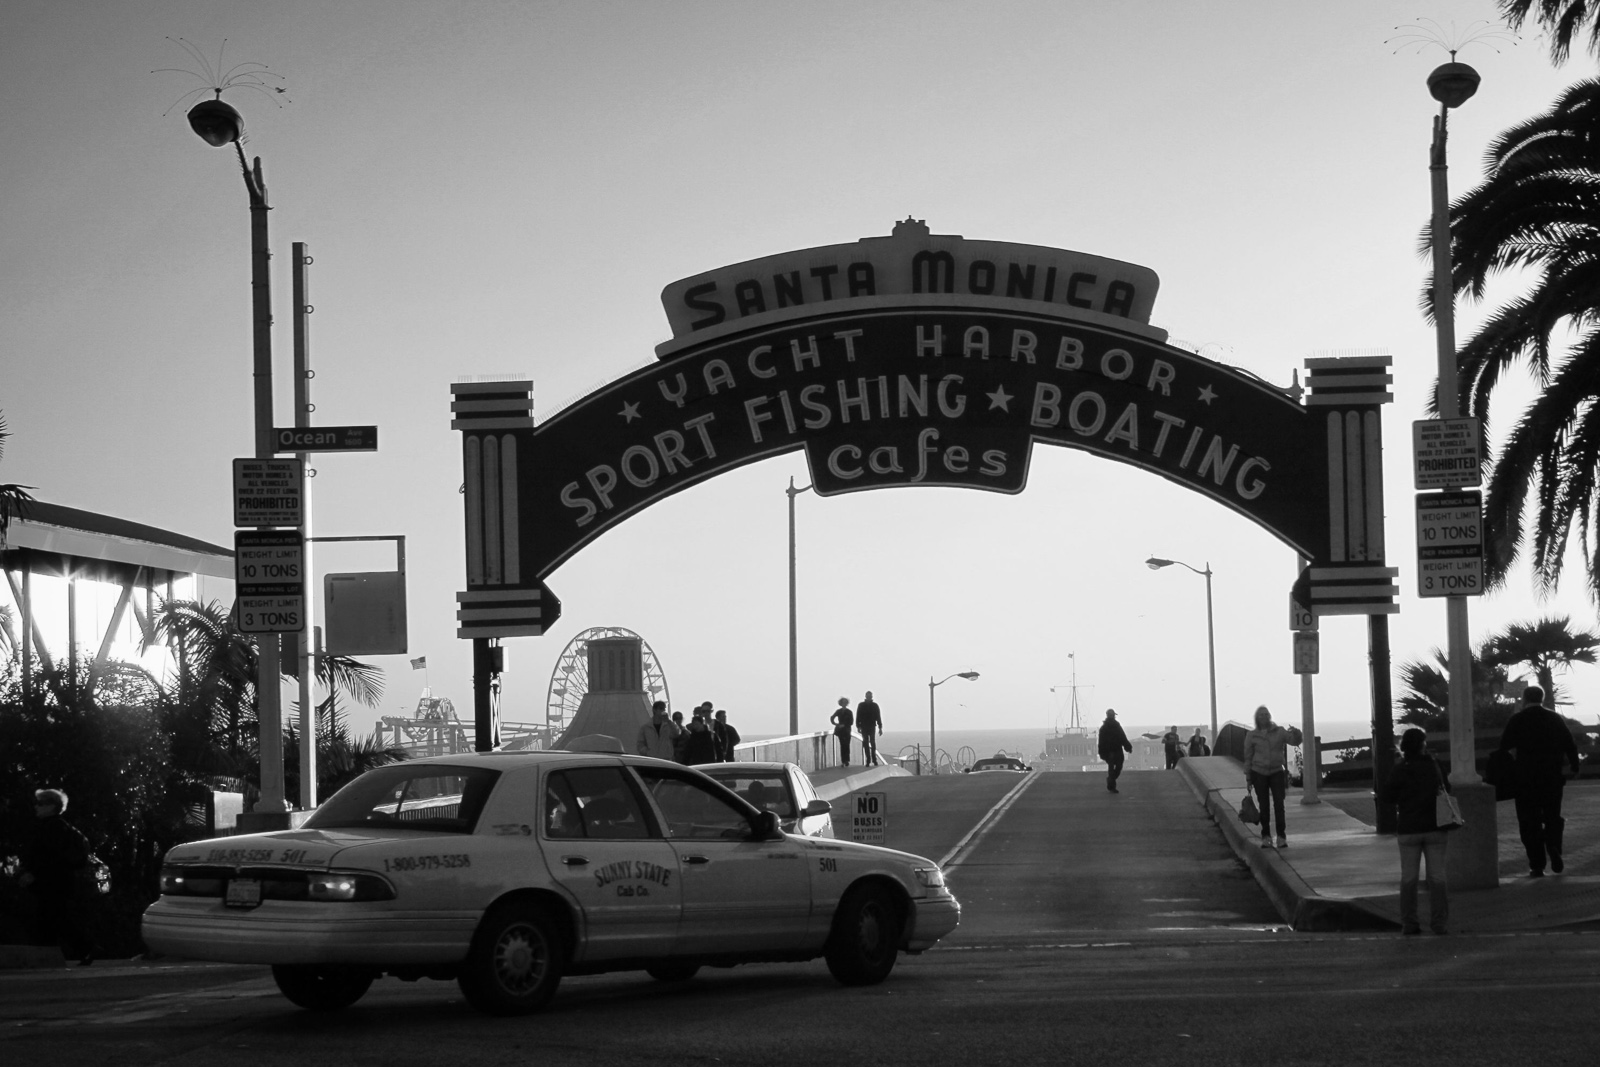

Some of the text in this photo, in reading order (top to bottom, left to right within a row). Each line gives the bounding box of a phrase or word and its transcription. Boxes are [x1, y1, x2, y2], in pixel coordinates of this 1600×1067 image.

[684, 250, 1136, 331] SANTA MONICA
[657, 325, 1176, 408] YACHT HARBOR
[280, 431, 336, 445] Ocean
[560, 375, 1272, 527] SPORT FISHING BOATING
[1418, 457, 1476, 471] PROHIBITED
[239, 497, 298, 509] PROHIBITED
[1422, 511, 1476, 521] WEIGHT LIMIT
[1422, 525, 1477, 540] 10 TONS
[242, 550, 298, 559] WEIGHT LIMIT
[242, 564, 298, 577] 10 TONS
[1423, 561, 1478, 571] WEIGHT LIMIT
[1425, 575, 1476, 589] 3 TONS
[277, 599, 298, 607] LIMIT
[245, 612, 298, 625] 3 TONS
[1295, 613, 1313, 626] 10
[857, 797, 878, 814] NO
[854, 817, 882, 826] BUSES
[281, 849, 307, 863] 501
[384, 854, 471, 872] 1-800-979-5258
[820, 857, 837, 872] 501
[593, 861, 671, 887] SUNNY STATE
[617, 885, 650, 897] Cab Co.
